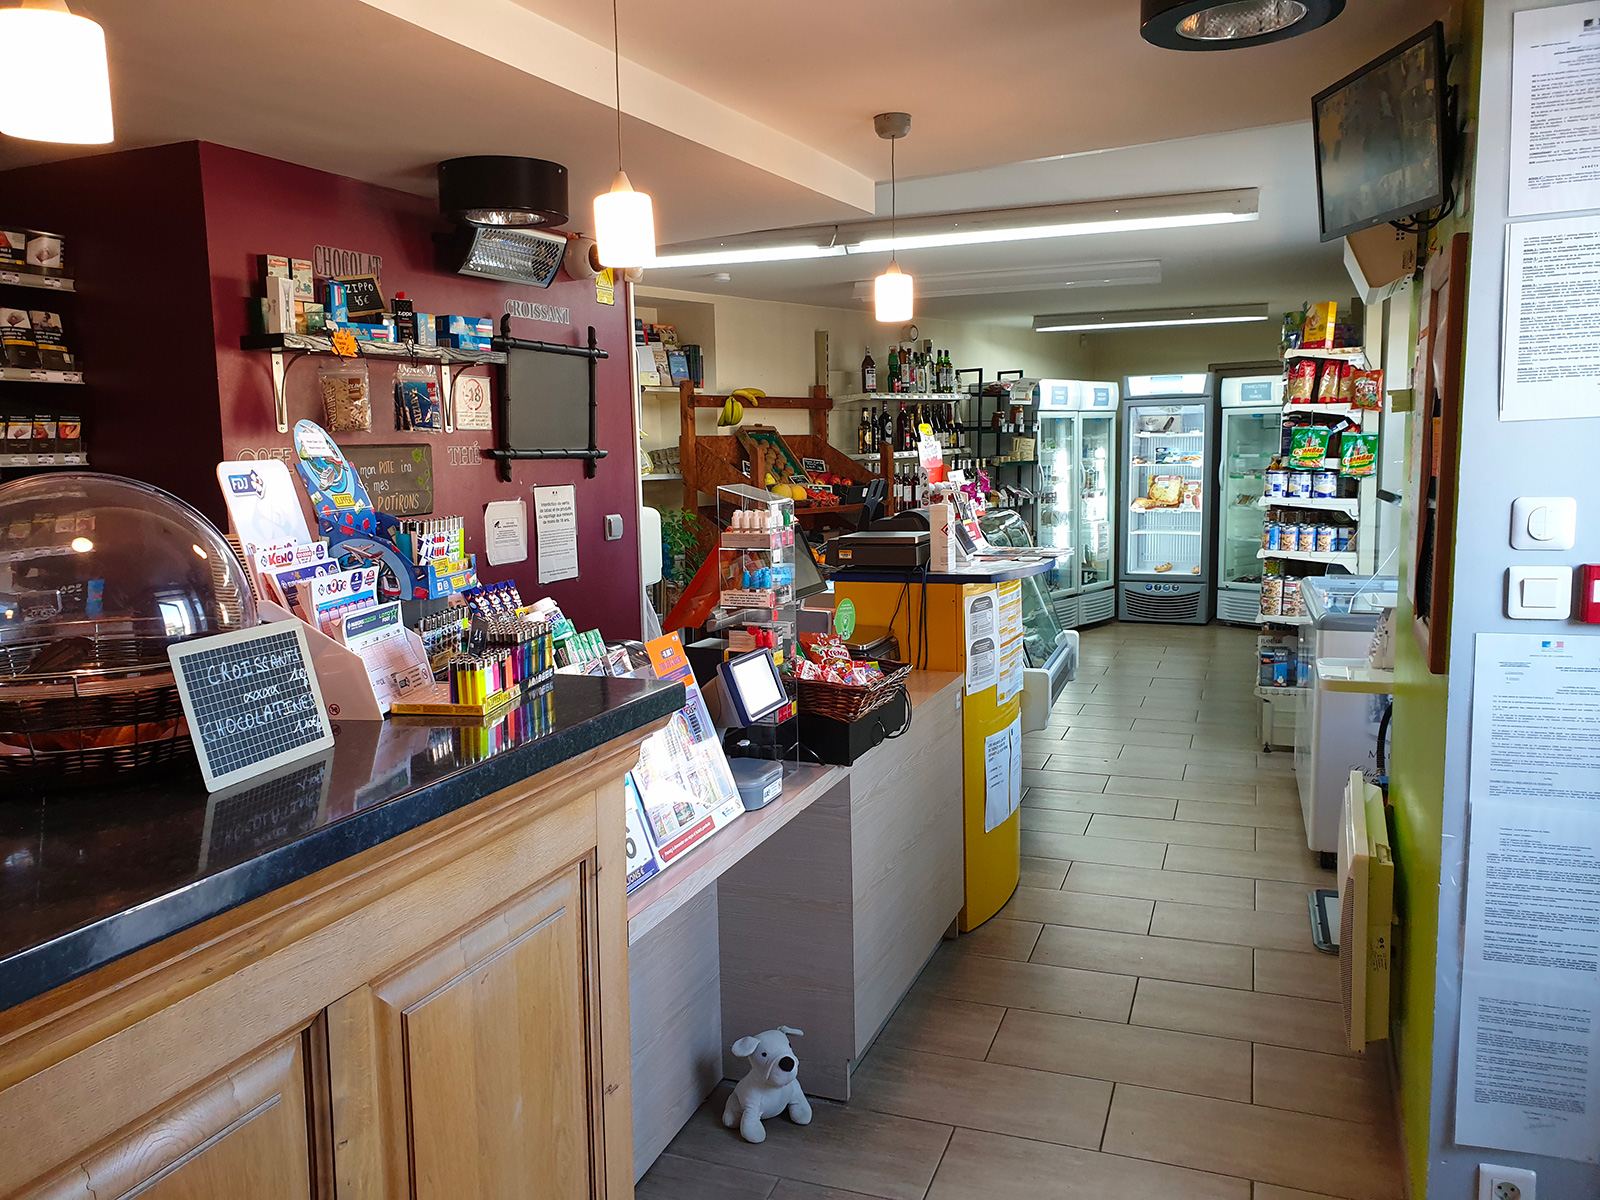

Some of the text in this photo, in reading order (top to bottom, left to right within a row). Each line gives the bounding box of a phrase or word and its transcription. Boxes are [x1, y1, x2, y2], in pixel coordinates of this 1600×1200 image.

[345, 281, 374, 294] ZIPPO
[353, 294, 370, 307] 45€
[505, 299, 571, 324] CROISSANT
[409, 387, 422, 424] RIZLA+
[447, 441, 482, 466] THÉ
[360, 460, 413, 479] mon POTE ira
[231, 476, 249, 490] FDJ
[373, 480, 390, 493] mes
[268, 551, 294, 566] KENO
[326, 578, 347, 595] LOTO
[207, 647, 300, 685] CROISSANTS
[202, 692, 316, 742] CHOCOLATINES
